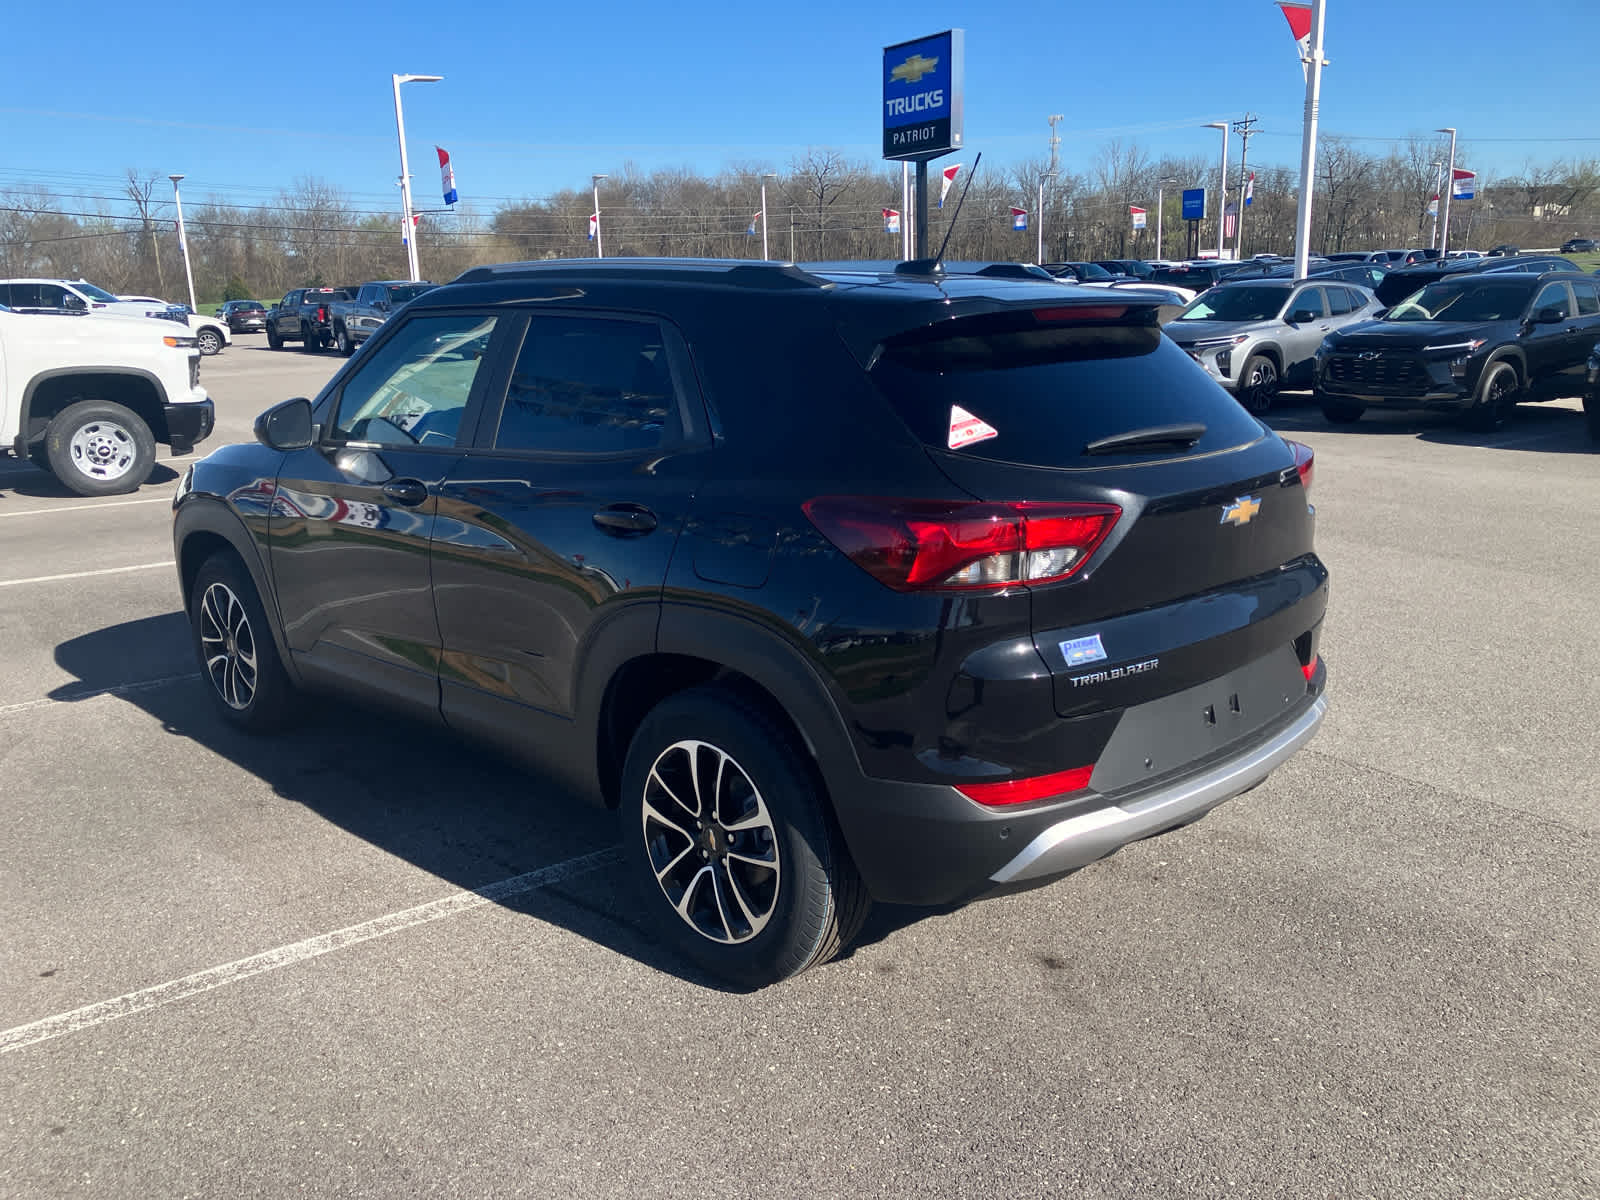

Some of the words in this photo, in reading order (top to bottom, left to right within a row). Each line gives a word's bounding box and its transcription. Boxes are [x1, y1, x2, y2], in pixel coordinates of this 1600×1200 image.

[886, 89, 944, 117] TRUCKS
[893, 126, 936, 145] PATRIOT
[1070, 658, 1160, 688] TRAILBLAZER
